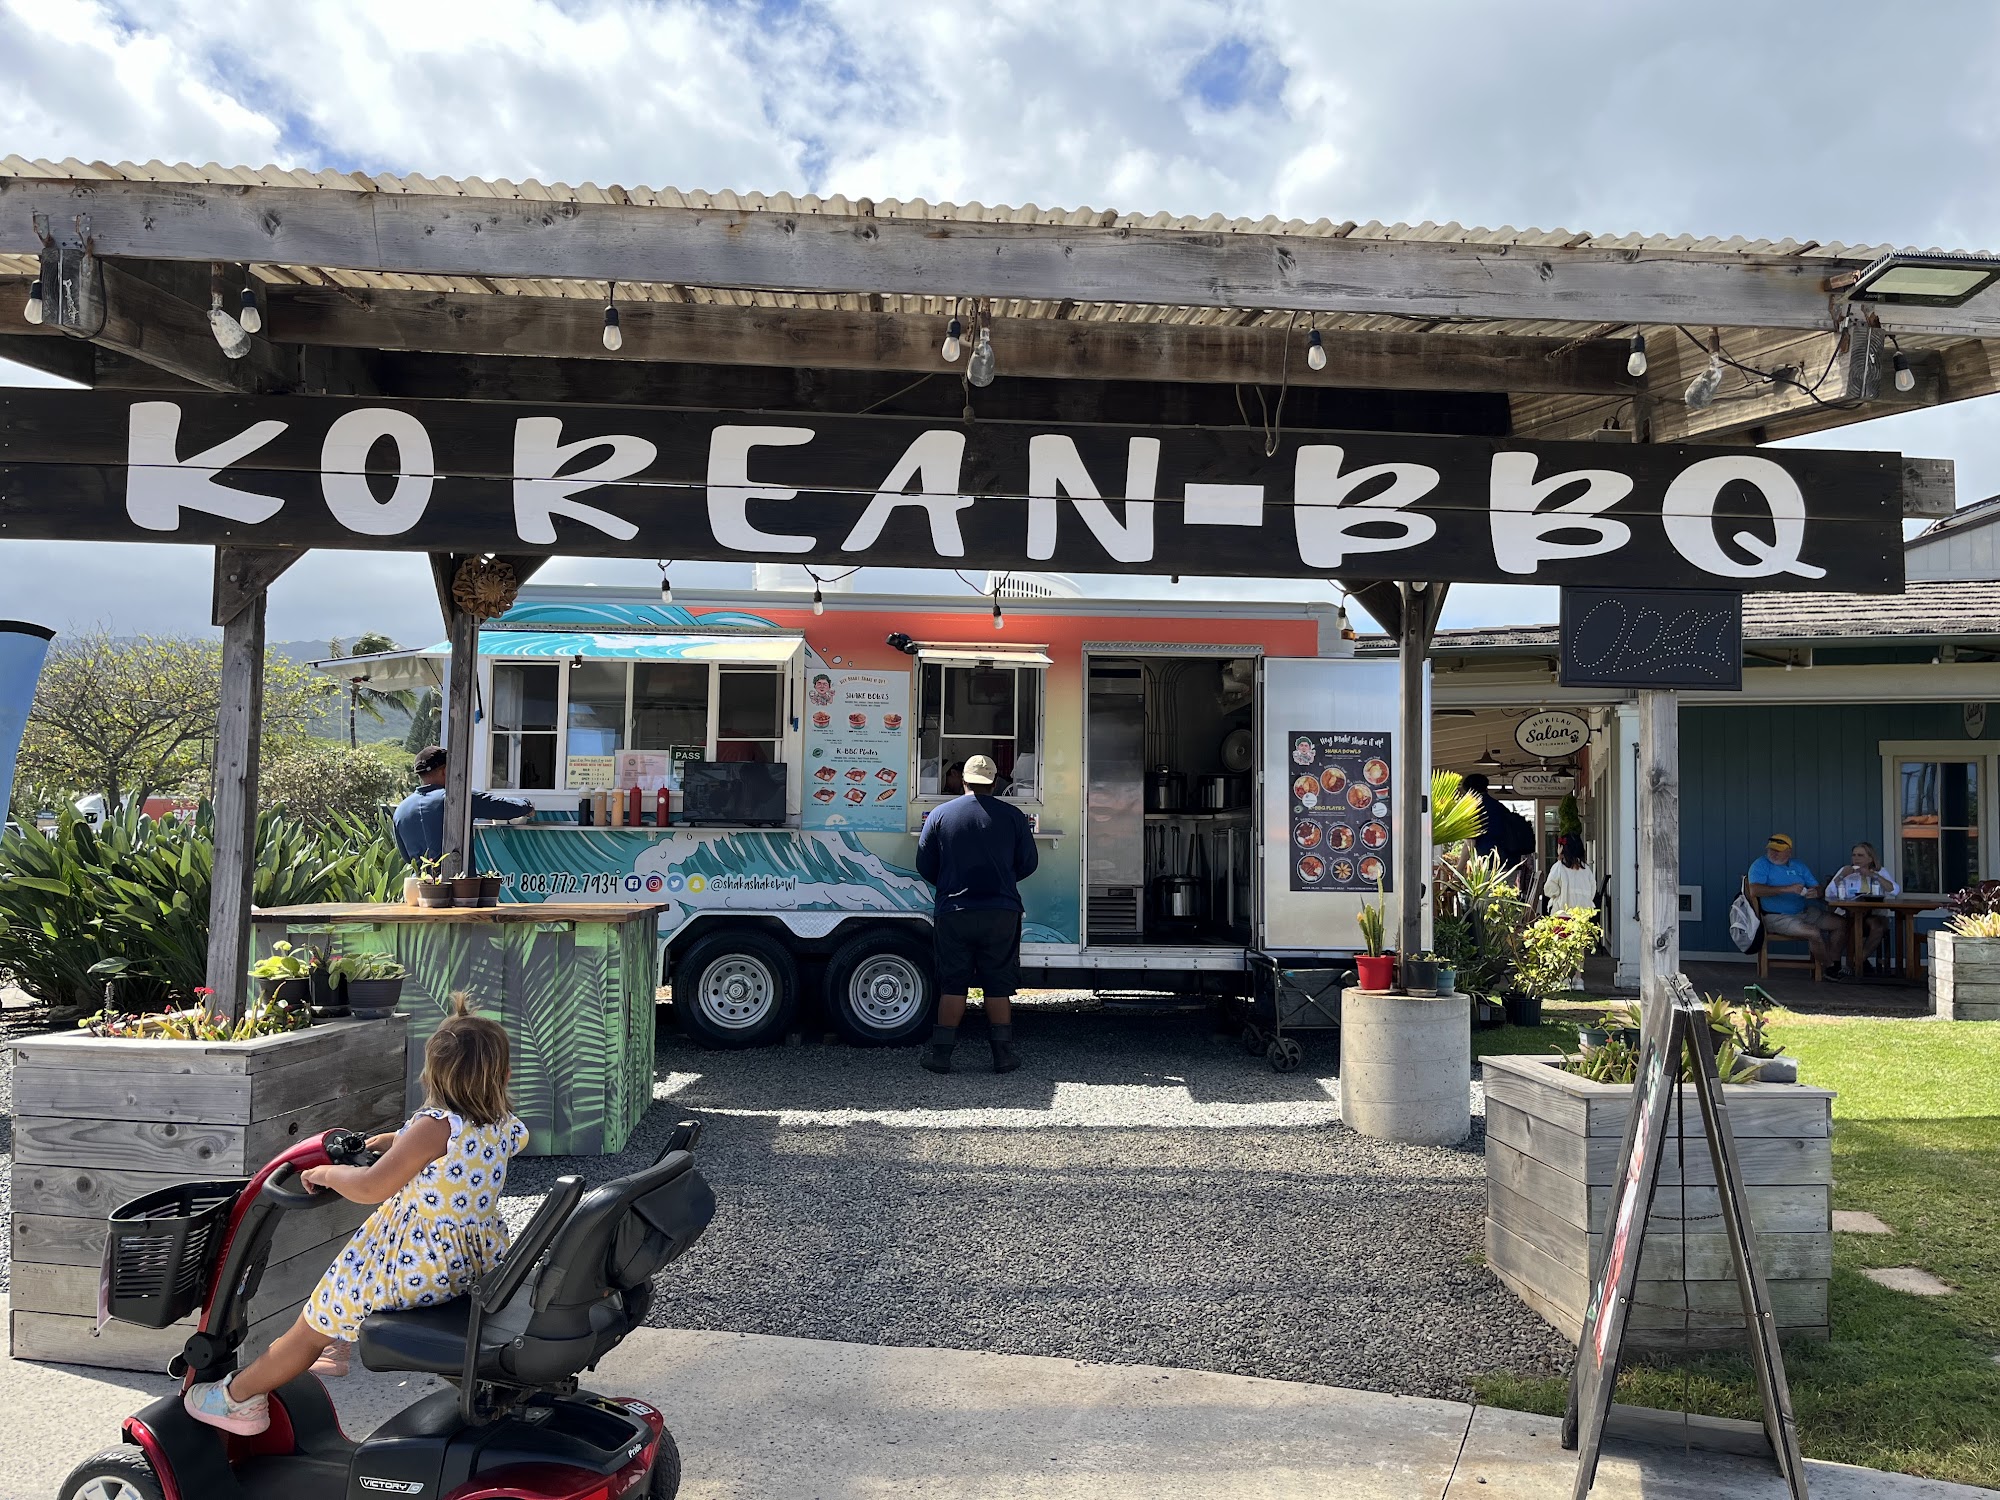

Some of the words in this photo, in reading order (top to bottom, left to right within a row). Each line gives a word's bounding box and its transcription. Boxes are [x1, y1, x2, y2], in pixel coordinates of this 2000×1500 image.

[1532, 718, 1571, 727] HUKILAU
[1526, 724, 1579, 743] Salon
[520, 873, 618, 894] 808.772.7934
[710, 876, 796, 892] @shakashakebowl
[628, 1444, 642, 1458] Pride
[363, 1479, 407, 1490] VICTORY
